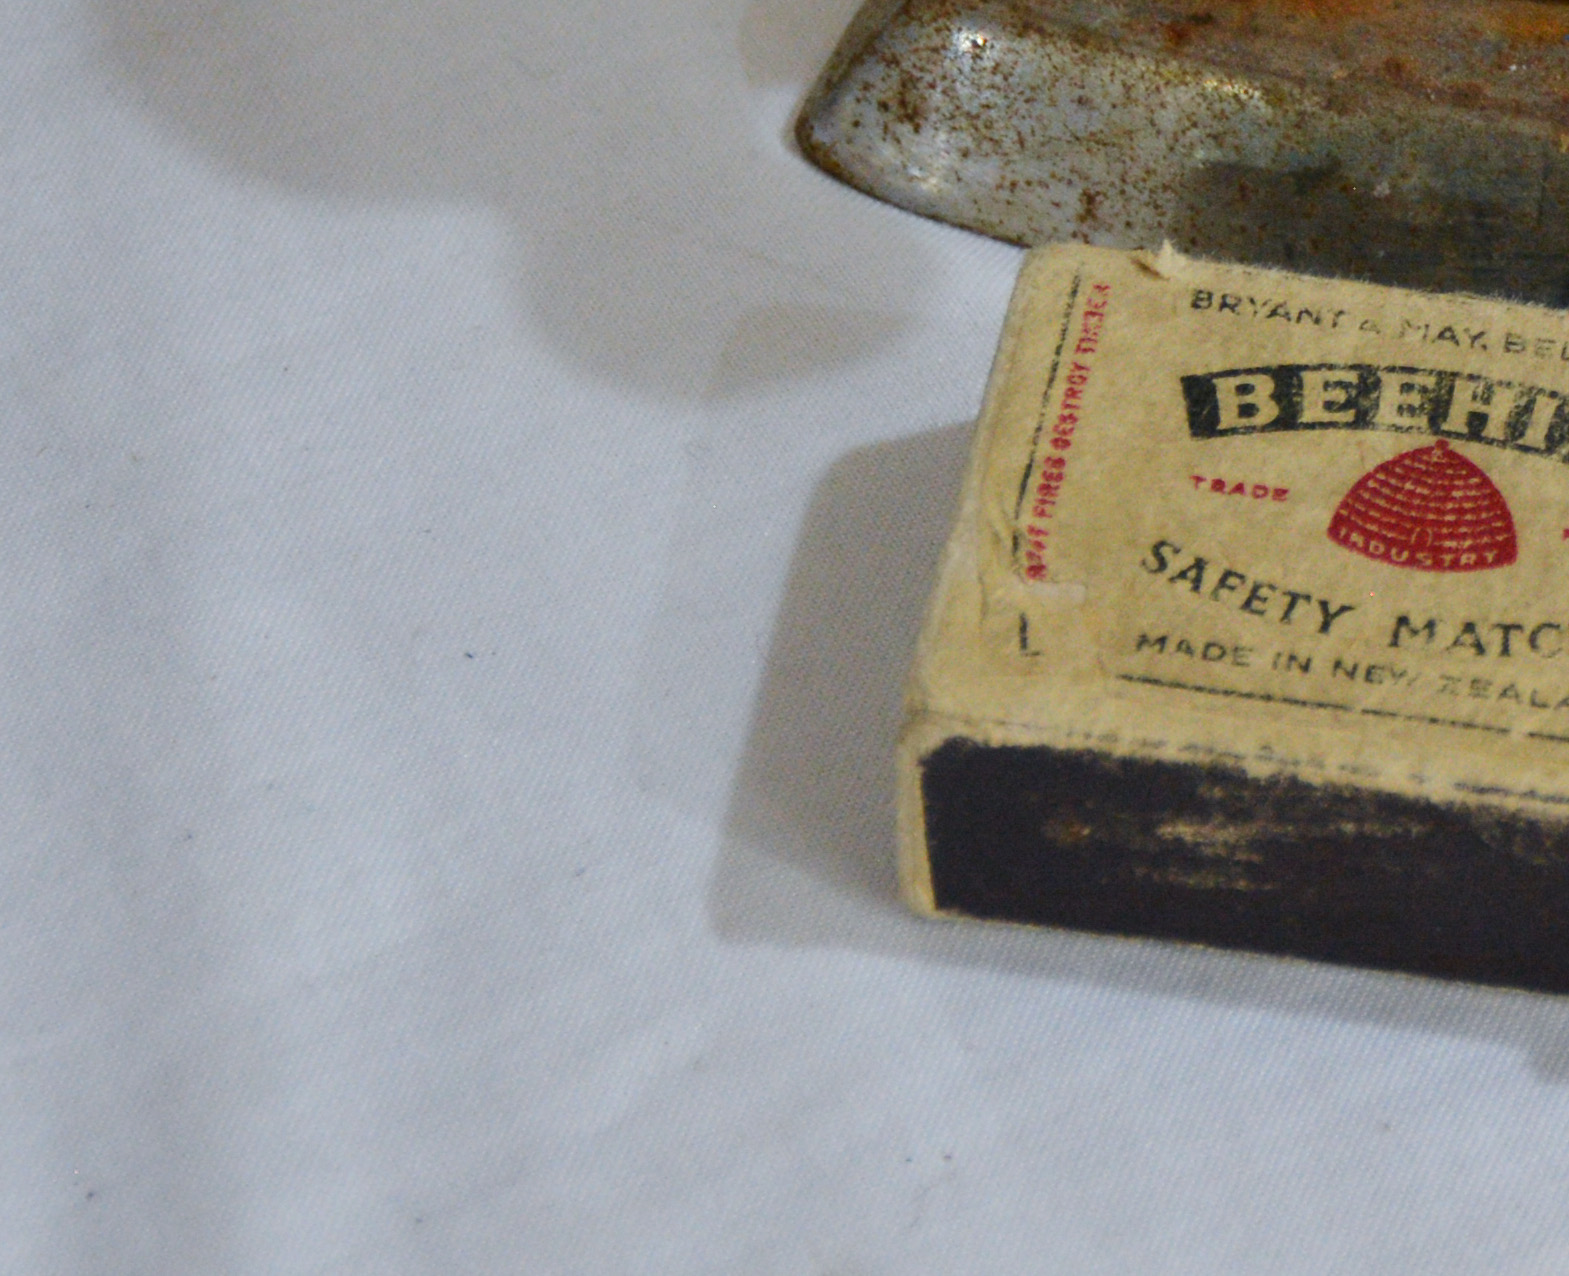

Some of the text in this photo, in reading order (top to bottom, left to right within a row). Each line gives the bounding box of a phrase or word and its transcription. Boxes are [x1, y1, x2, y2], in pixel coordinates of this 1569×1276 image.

[1191, 290, 1347, 329] BRYANT
[1032, 455, 1067, 519] FIRES
[1050, 361, 1092, 451] DESTROY
[1189, 475, 1289, 502] TRADE
[1338, 525, 1500, 569] INDUSTRY
[1141, 539, 1356, 635] SAFETY
[1137, 633, 1253, 667] MADE
[1271, 651, 1313, 674] IN
[1332, 659, 1420, 687] NEW
